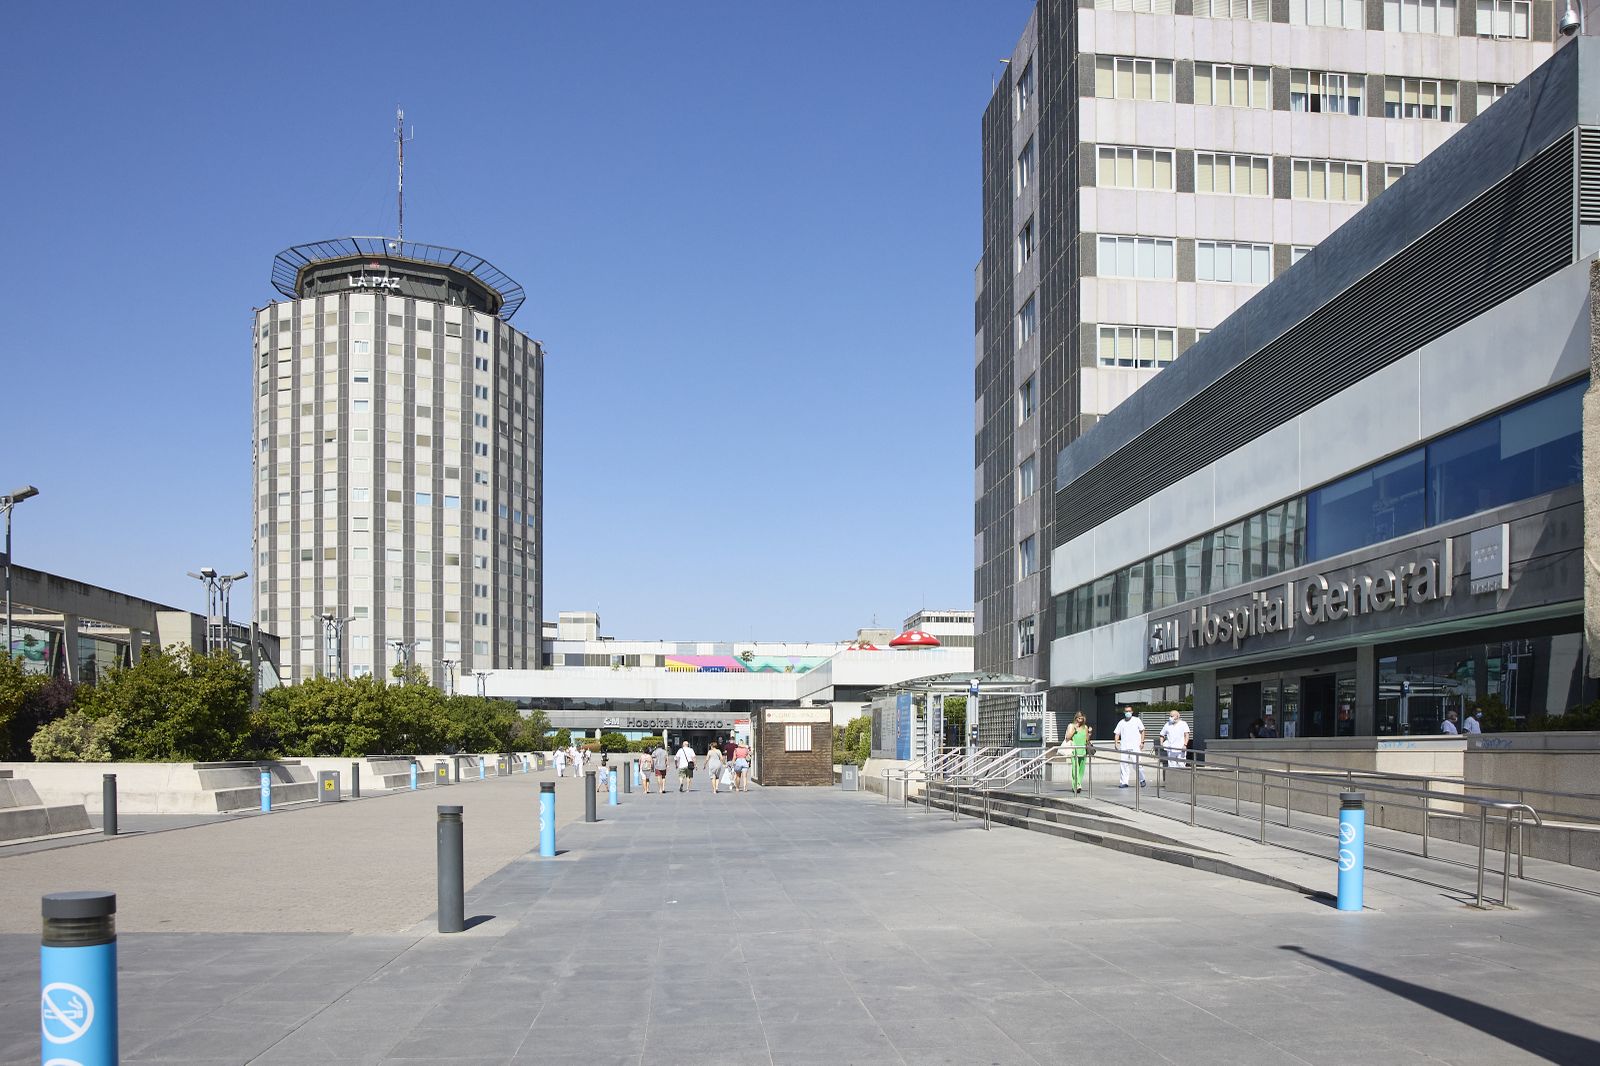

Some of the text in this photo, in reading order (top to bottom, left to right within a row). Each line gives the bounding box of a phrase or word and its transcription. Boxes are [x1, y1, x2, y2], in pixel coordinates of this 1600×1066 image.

[349, 275, 400, 288] LA PAZ
[1188, 538, 1453, 650] Hospital General
[626, 717, 674, 730] Hospital
[676, 717, 724, 729] Materno
